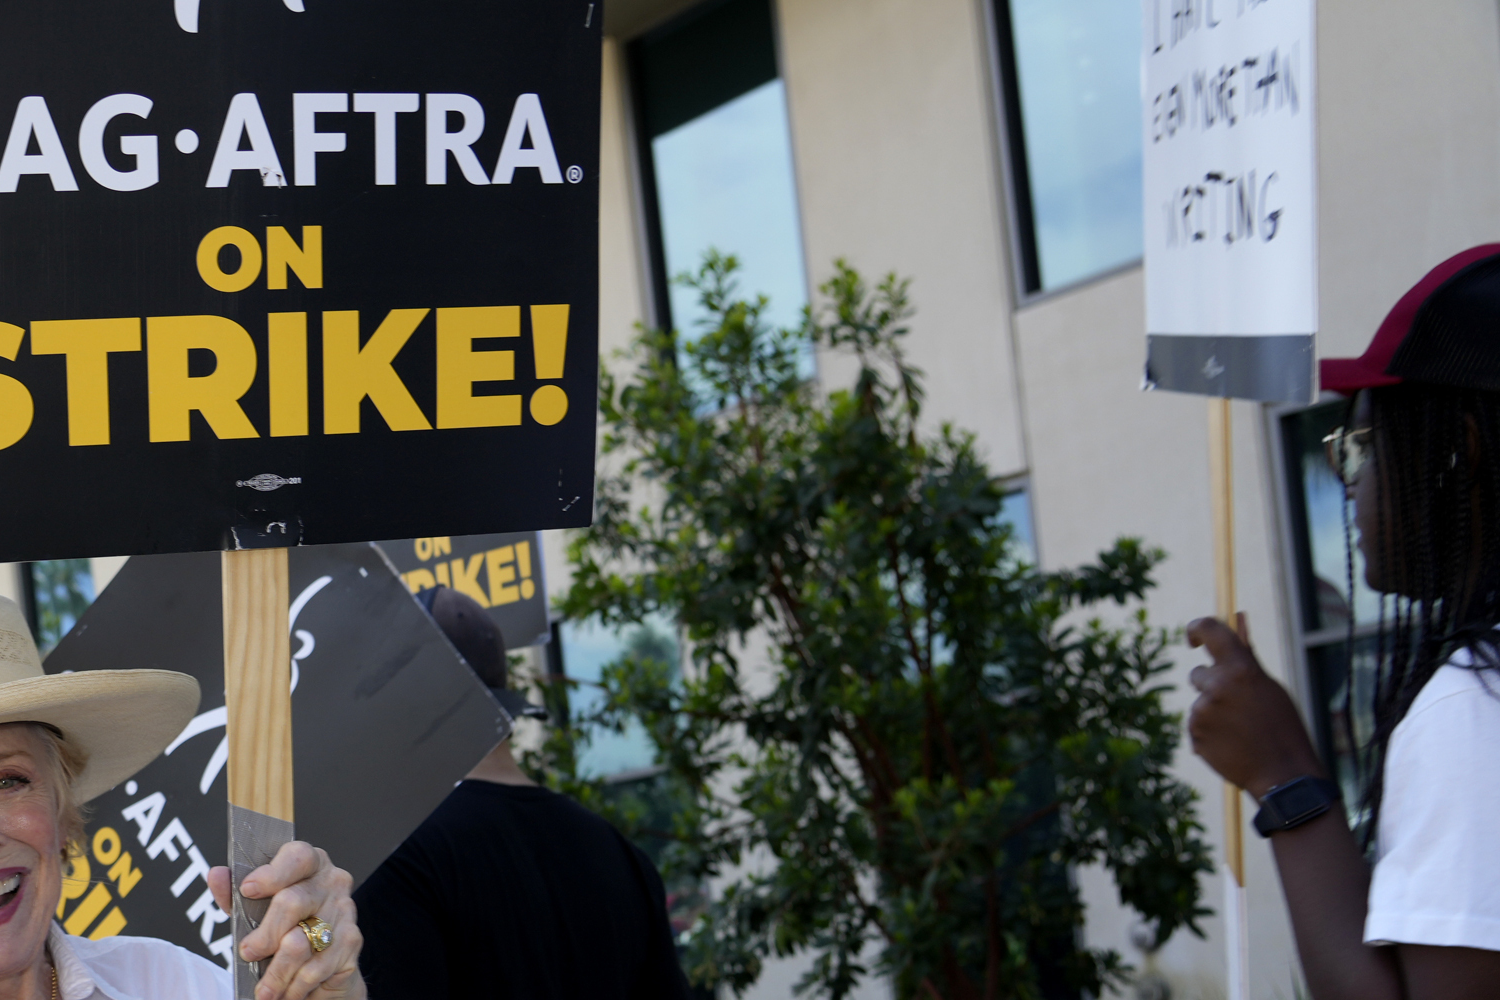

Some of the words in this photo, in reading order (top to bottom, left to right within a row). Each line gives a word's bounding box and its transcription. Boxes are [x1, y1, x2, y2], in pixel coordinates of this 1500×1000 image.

[1161, 168, 1284, 251] WRITING
[195, 225, 323, 293] ON
[414, 536, 452, 562] ON
[92, 827, 143, 898] ON
